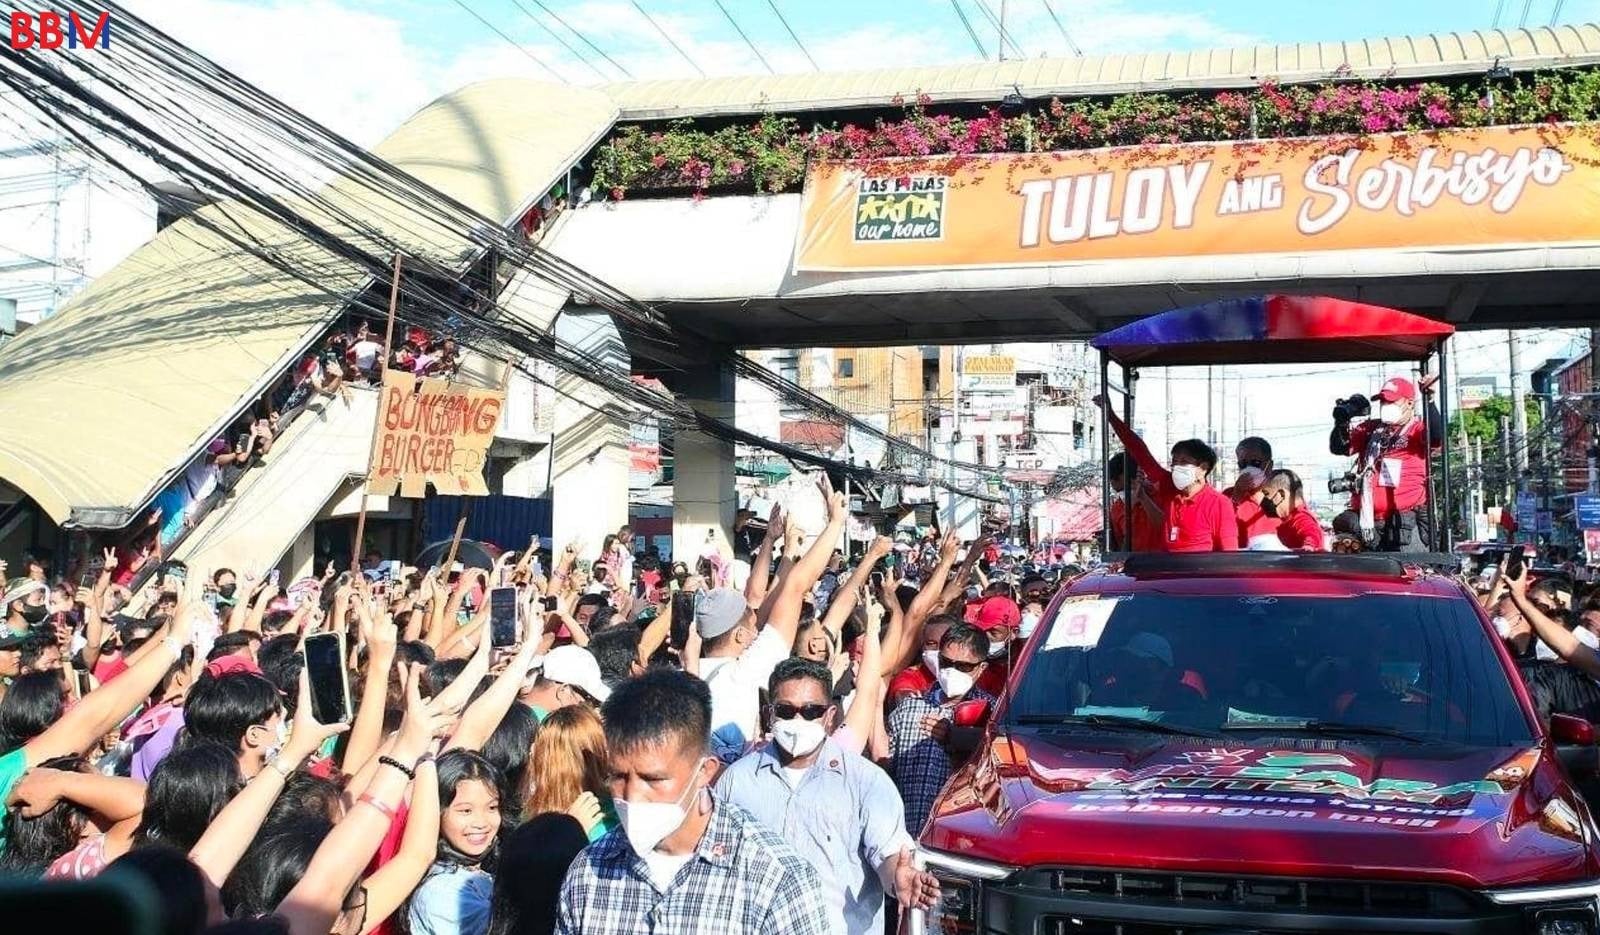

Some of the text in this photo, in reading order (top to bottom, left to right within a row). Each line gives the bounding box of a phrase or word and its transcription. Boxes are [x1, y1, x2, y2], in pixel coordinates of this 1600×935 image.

[860, 179, 888, 192] LAS
[1019, 148, 1574, 248] TULOY ANG Serbisyo
[859, 221, 938, 239] our home
[1016, 459, 1043, 470] TGP
[1068, 804, 1317, 818] babangon
